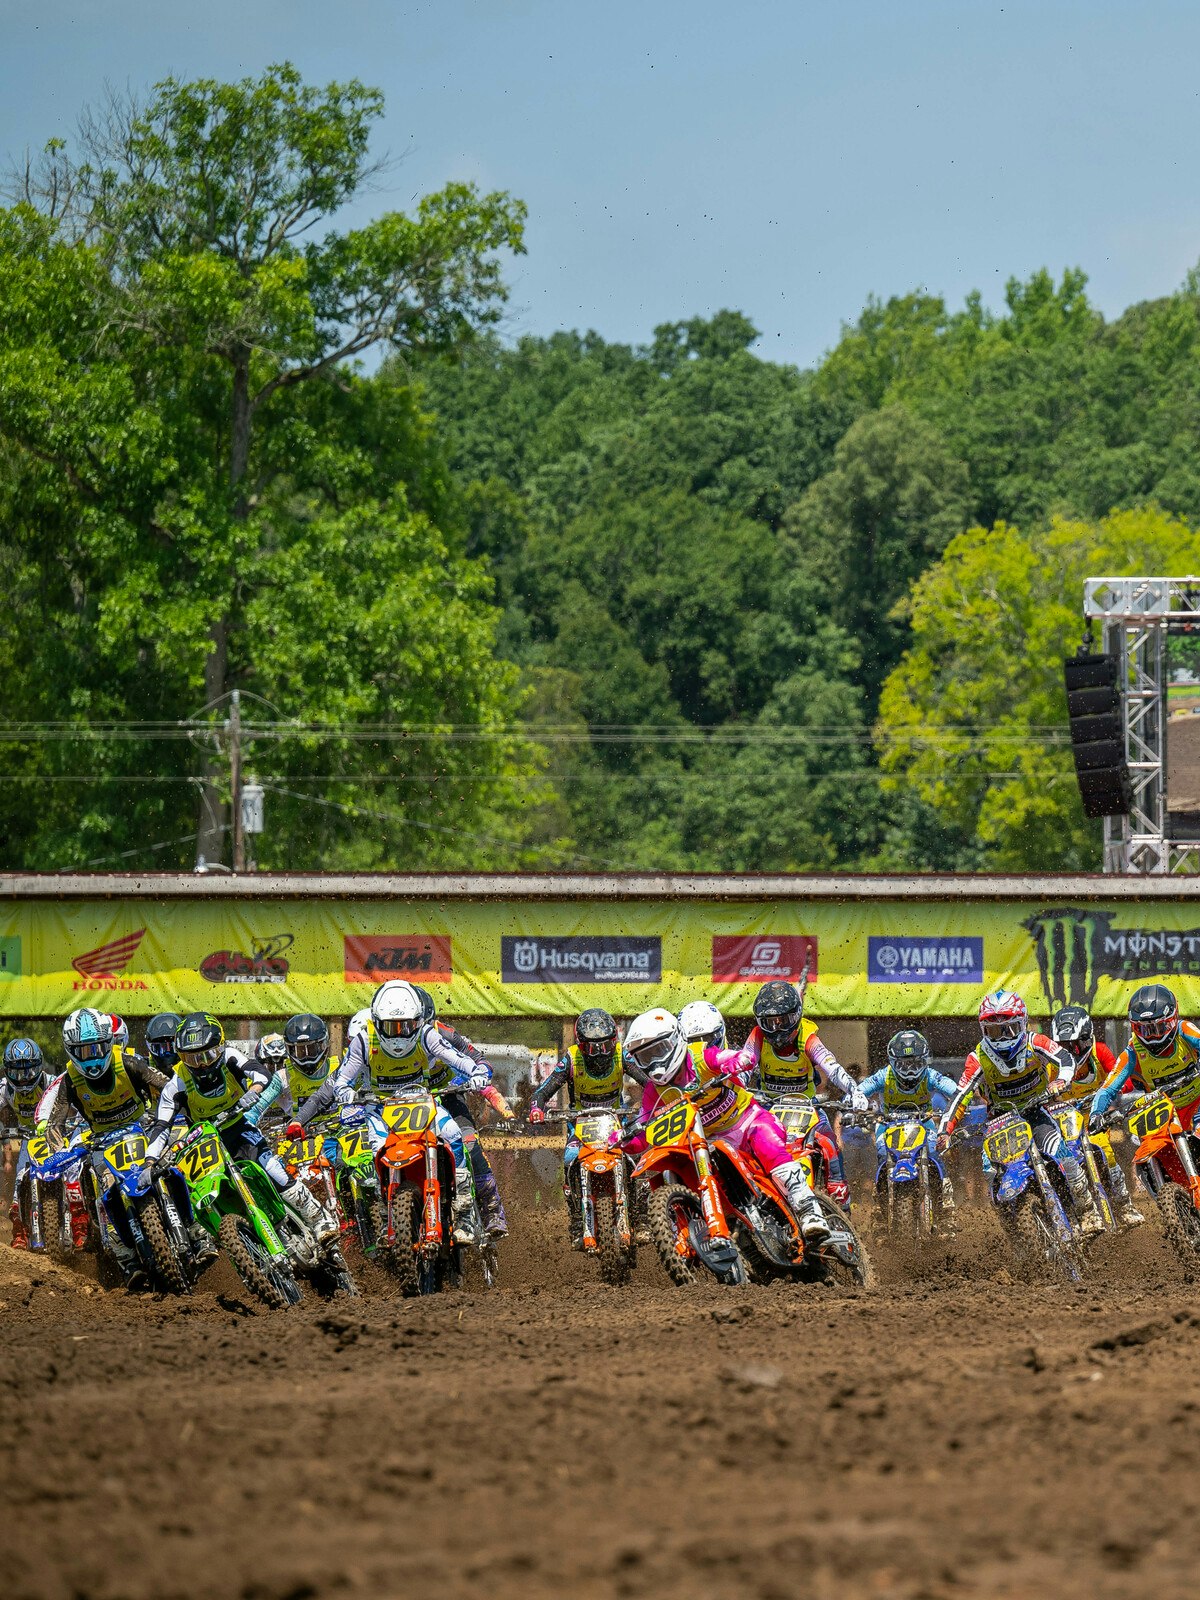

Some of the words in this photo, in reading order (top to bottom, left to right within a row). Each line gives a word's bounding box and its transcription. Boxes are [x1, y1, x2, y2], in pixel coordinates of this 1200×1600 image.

[363, 947, 432, 972] KTM
[540, 949, 651, 972] Husqvarna
[900, 947, 974, 967] YAMAHA
[72, 980, 149, 992] HONDA
[392, 1106, 430, 1132] 20
[701, 1089, 735, 1125] HAMPIONSHIP
[1131, 1101, 1169, 1136] 16
[652, 1108, 687, 1146] 28
[889, 1126, 921, 1149] 17
[110, 1139, 145, 1168] 19
[186, 1139, 219, 1182] 29
[711, 1179, 723, 1214] DUNLOP
